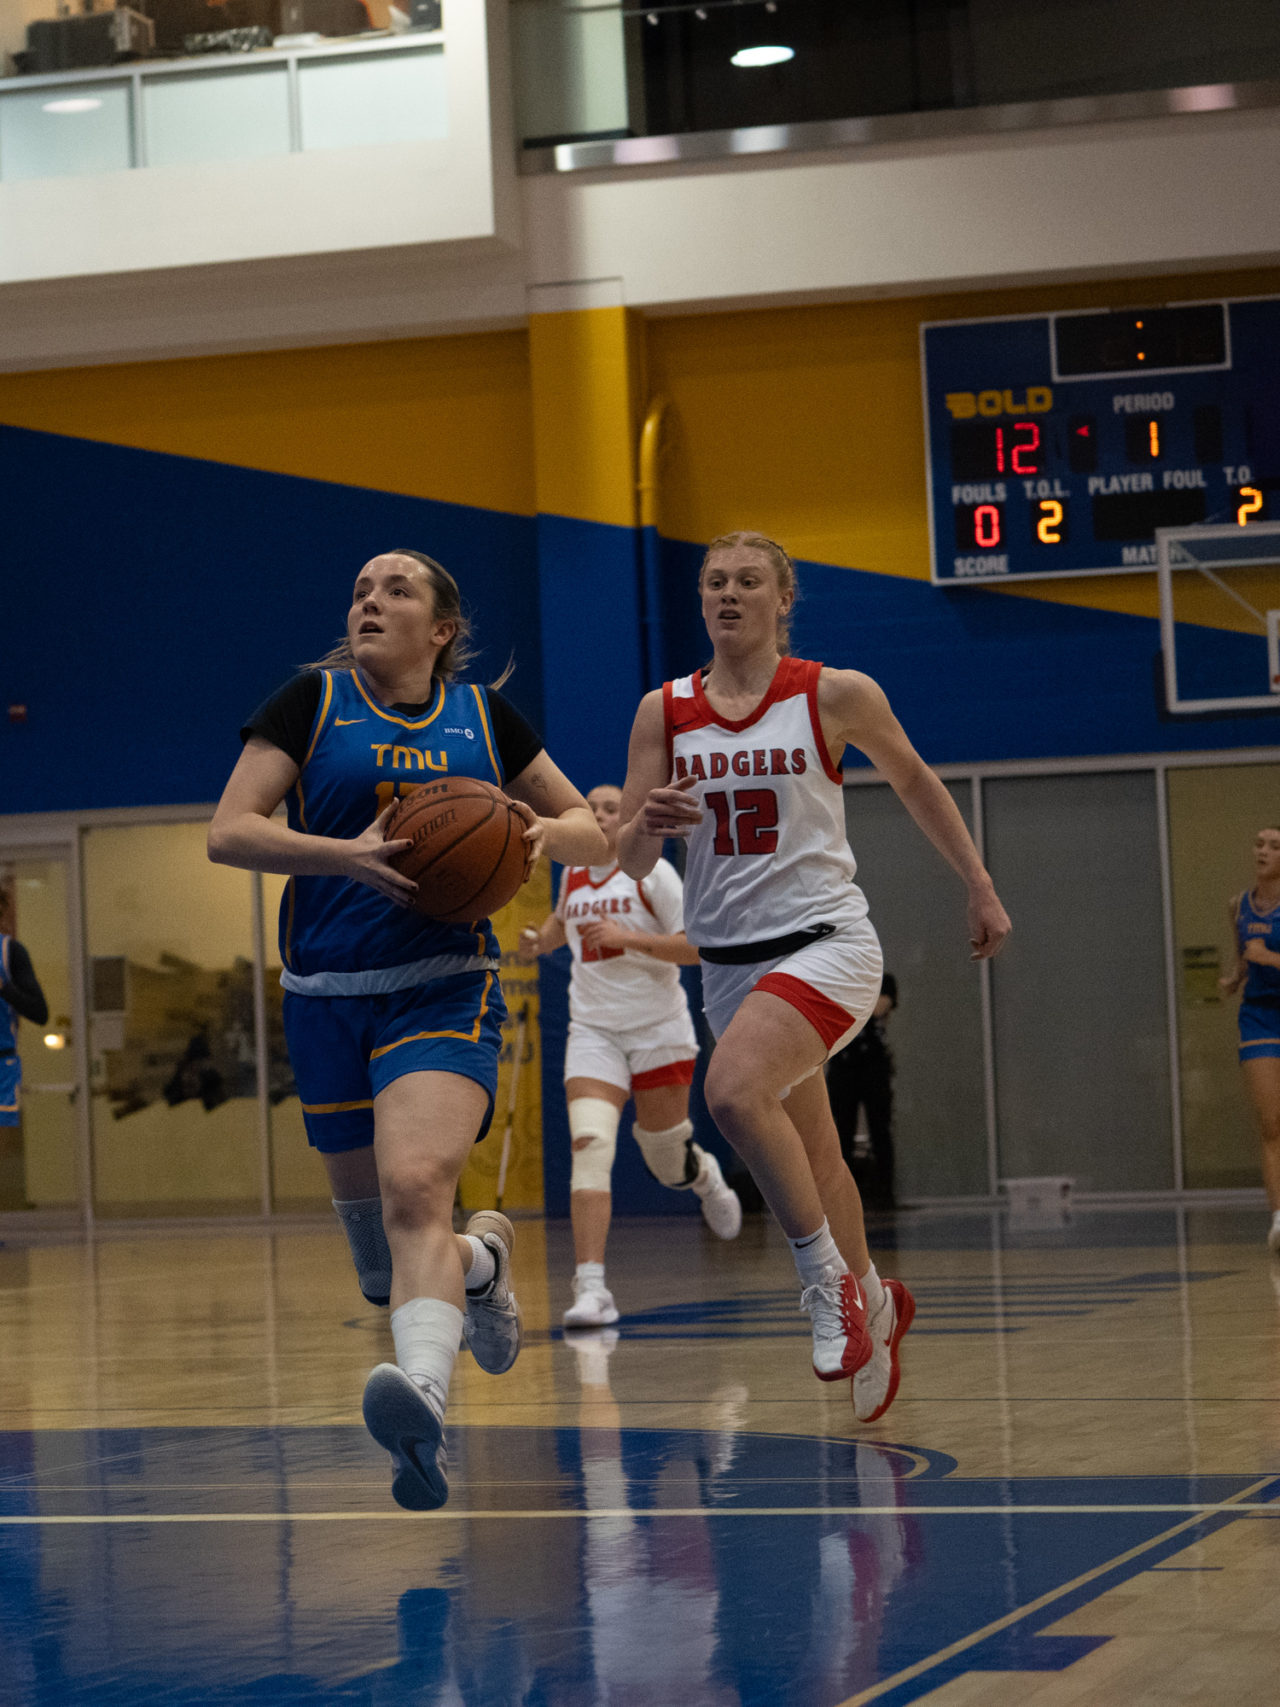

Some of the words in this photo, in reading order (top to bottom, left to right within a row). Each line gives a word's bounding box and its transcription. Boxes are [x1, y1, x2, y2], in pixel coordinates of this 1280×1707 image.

[945, 386, 1053, 419] BOLD
[1113, 392, 1175, 414] PERIOD
[996, 422, 1040, 474] 12
[1149, 421, 1160, 457] 1
[951, 483, 1007, 505] FOULS
[1088, 473, 1153, 496] PLAYER
[1163, 469, 1208, 490] FOUL
[973, 505, 1000, 547] 0
[1037, 500, 1064, 544] 2
[954, 554, 1010, 577] SCORE
[443, 727, 464, 736] BMO
[370, 743, 449, 773] TMU
[675, 748, 807, 781] BADGERS
[704, 788, 779, 856] 12
